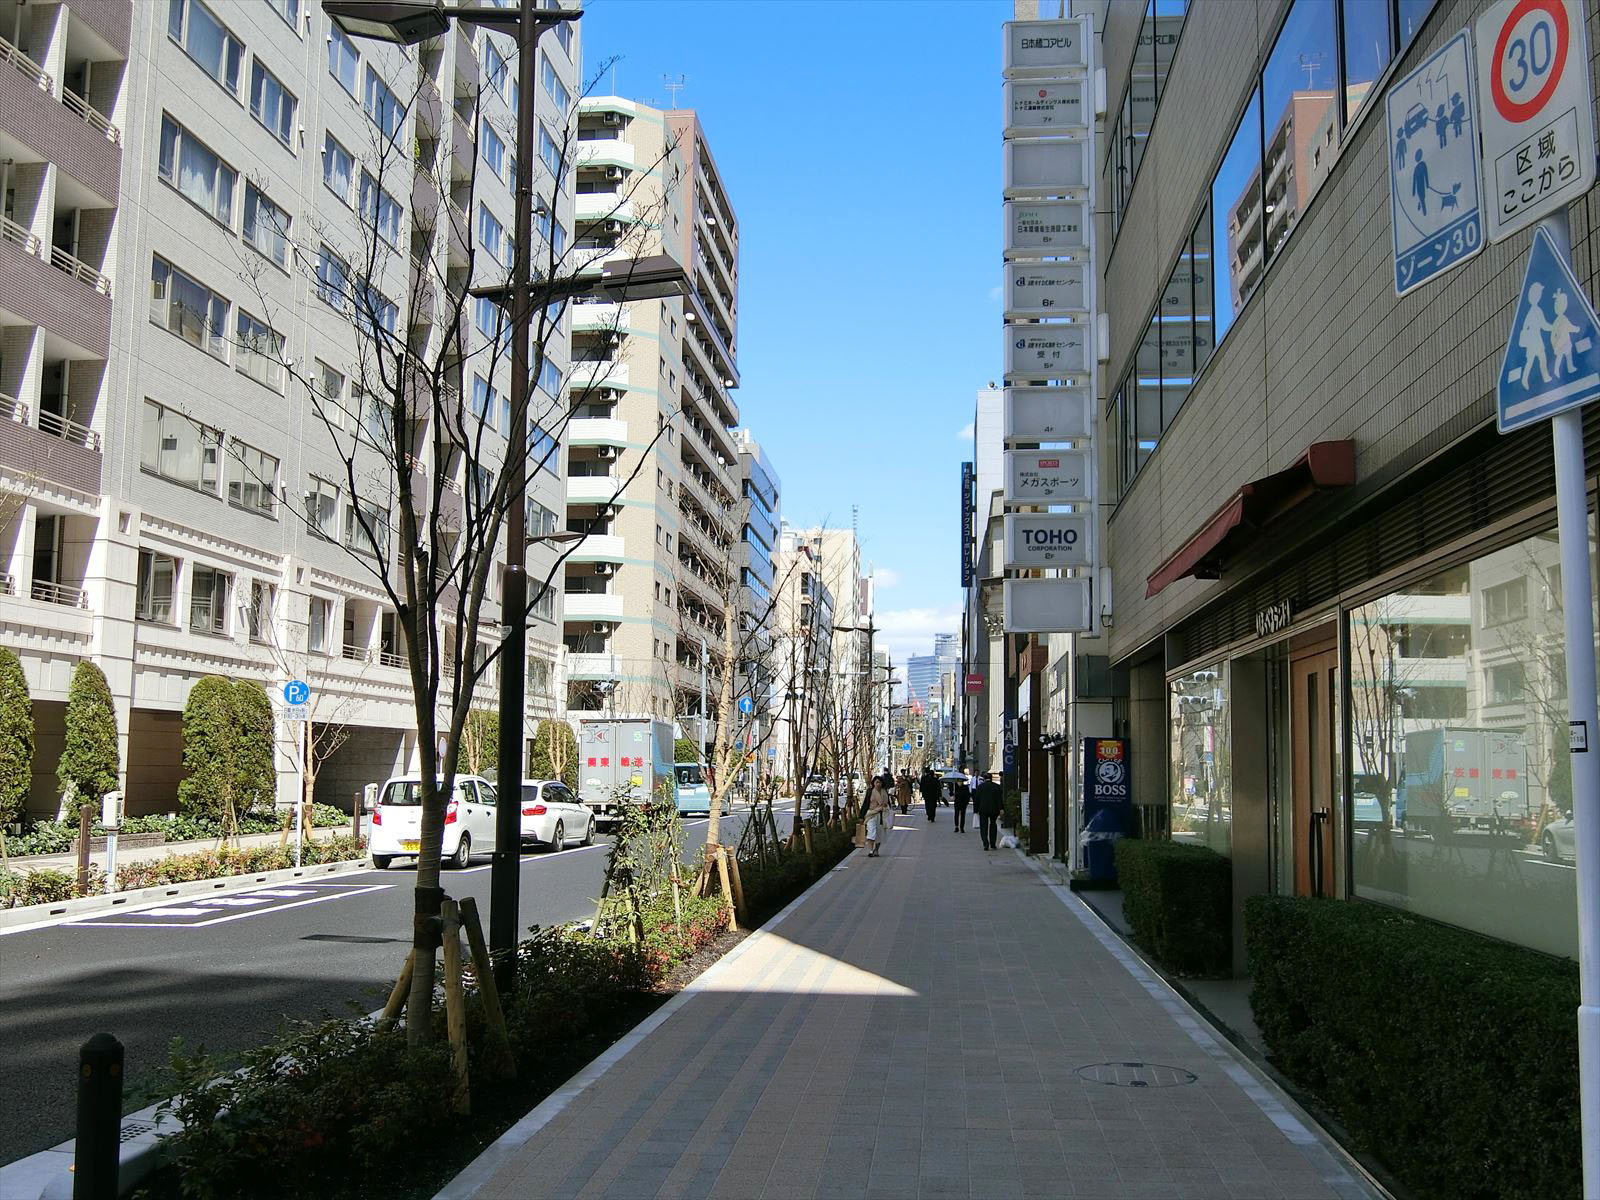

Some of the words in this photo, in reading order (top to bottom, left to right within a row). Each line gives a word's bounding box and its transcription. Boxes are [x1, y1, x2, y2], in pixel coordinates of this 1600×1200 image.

[1021, 37, 1072, 49] 日本橋コアビル
[1508, 20, 1551, 92] 30
[1515, 130, 1556, 176] 区域
[1503, 155, 1575, 215] ここから
[1400, 221, 1477, 286] ゾーン30
[1042, 298, 1054, 307] 6F
[1020, 477, 1079, 488] メガスポーツ
[1022, 529, 1078, 544] TOHO
[289, 685, 300, 702] P
[1094, 784, 1127, 796] BOSS
